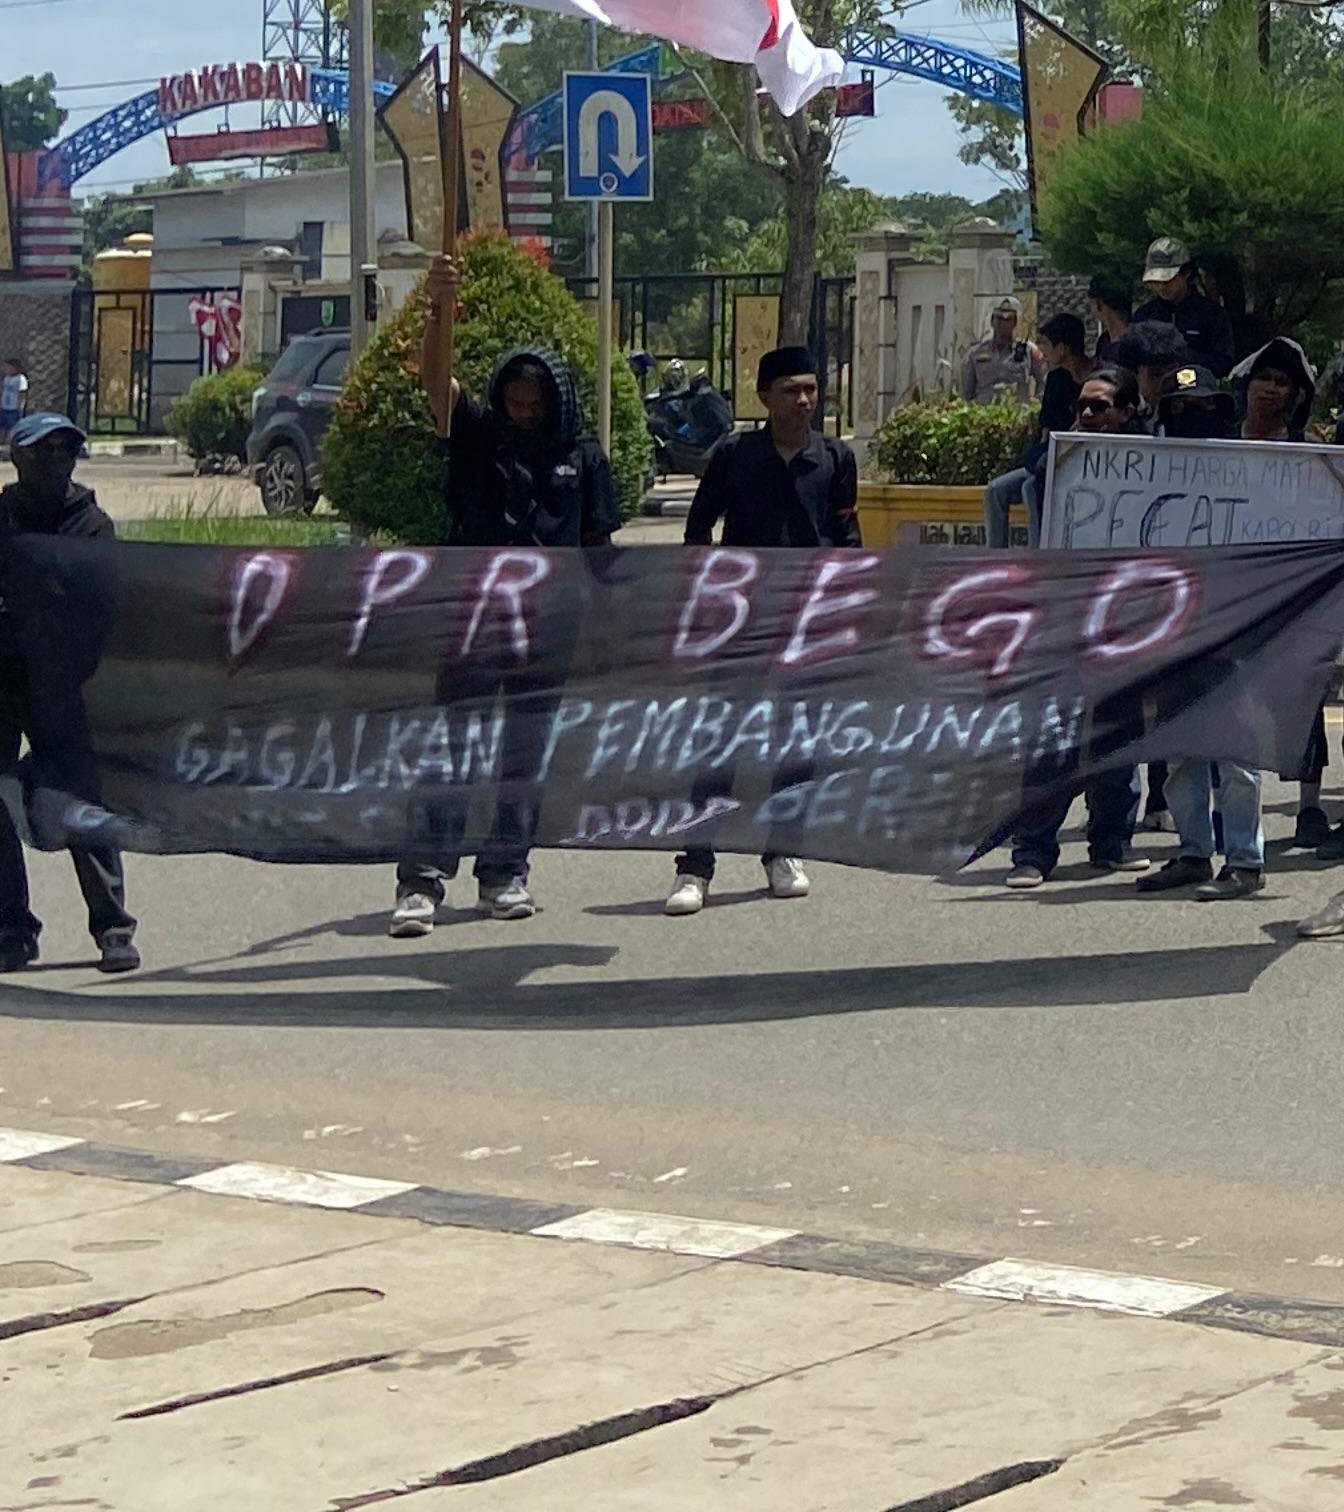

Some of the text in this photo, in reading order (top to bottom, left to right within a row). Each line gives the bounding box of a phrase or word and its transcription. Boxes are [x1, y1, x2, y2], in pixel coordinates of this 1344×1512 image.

[160, 62, 309, 112] KAKABAN
[1082, 449, 1156, 483] NKRI
[1167, 454, 1249, 488] HARGA
[226, 548, 1194, 678] DPR BEGO
[537, 696, 1086, 782] PEMBANGUNAN
